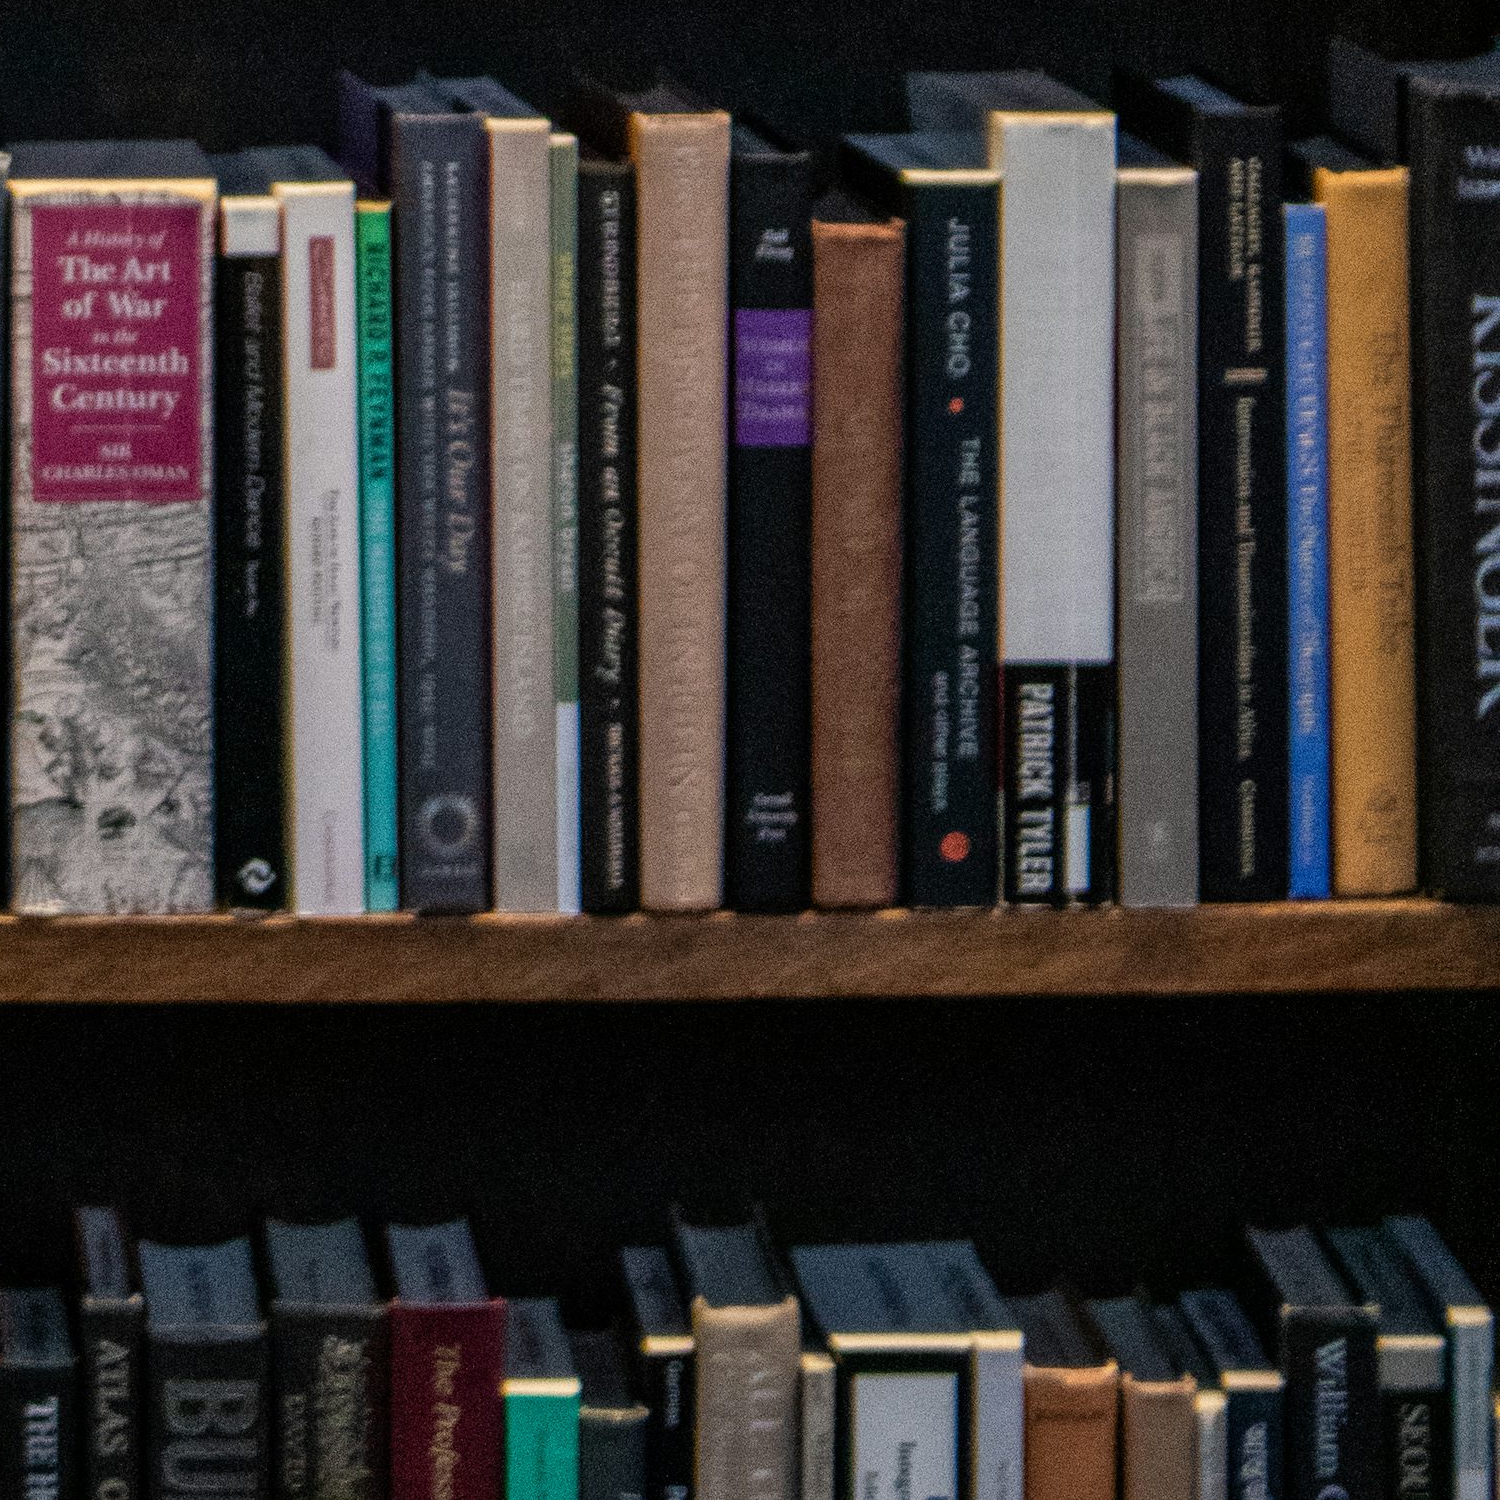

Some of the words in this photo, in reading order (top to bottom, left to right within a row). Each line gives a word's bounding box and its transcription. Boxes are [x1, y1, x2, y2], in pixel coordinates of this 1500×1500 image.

[57, 256, 114, 283] The
[122, 256, 172, 283] Art
[947, 217, 971, 302] JULIA
[62, 291, 96, 319] of
[109, 291, 168, 319] War
[41, 347, 190, 376] Sixteenth
[947, 311, 971, 379] CHO
[50, 383, 181, 420] Century
[444, 441, 476, 506] Our
[959, 437, 982, 485] THE
[444, 513, 476, 574] Day
[959, 495, 982, 635] LANGUAGE
[959, 646, 982, 759] ARCHIVE
[1017, 683, 1053, 799] PATRICK
[1017, 807, 1053, 893] TYLER
[97, 1340, 131, 1456] ATLAS
[1314, 1337, 1347, 1477] William
